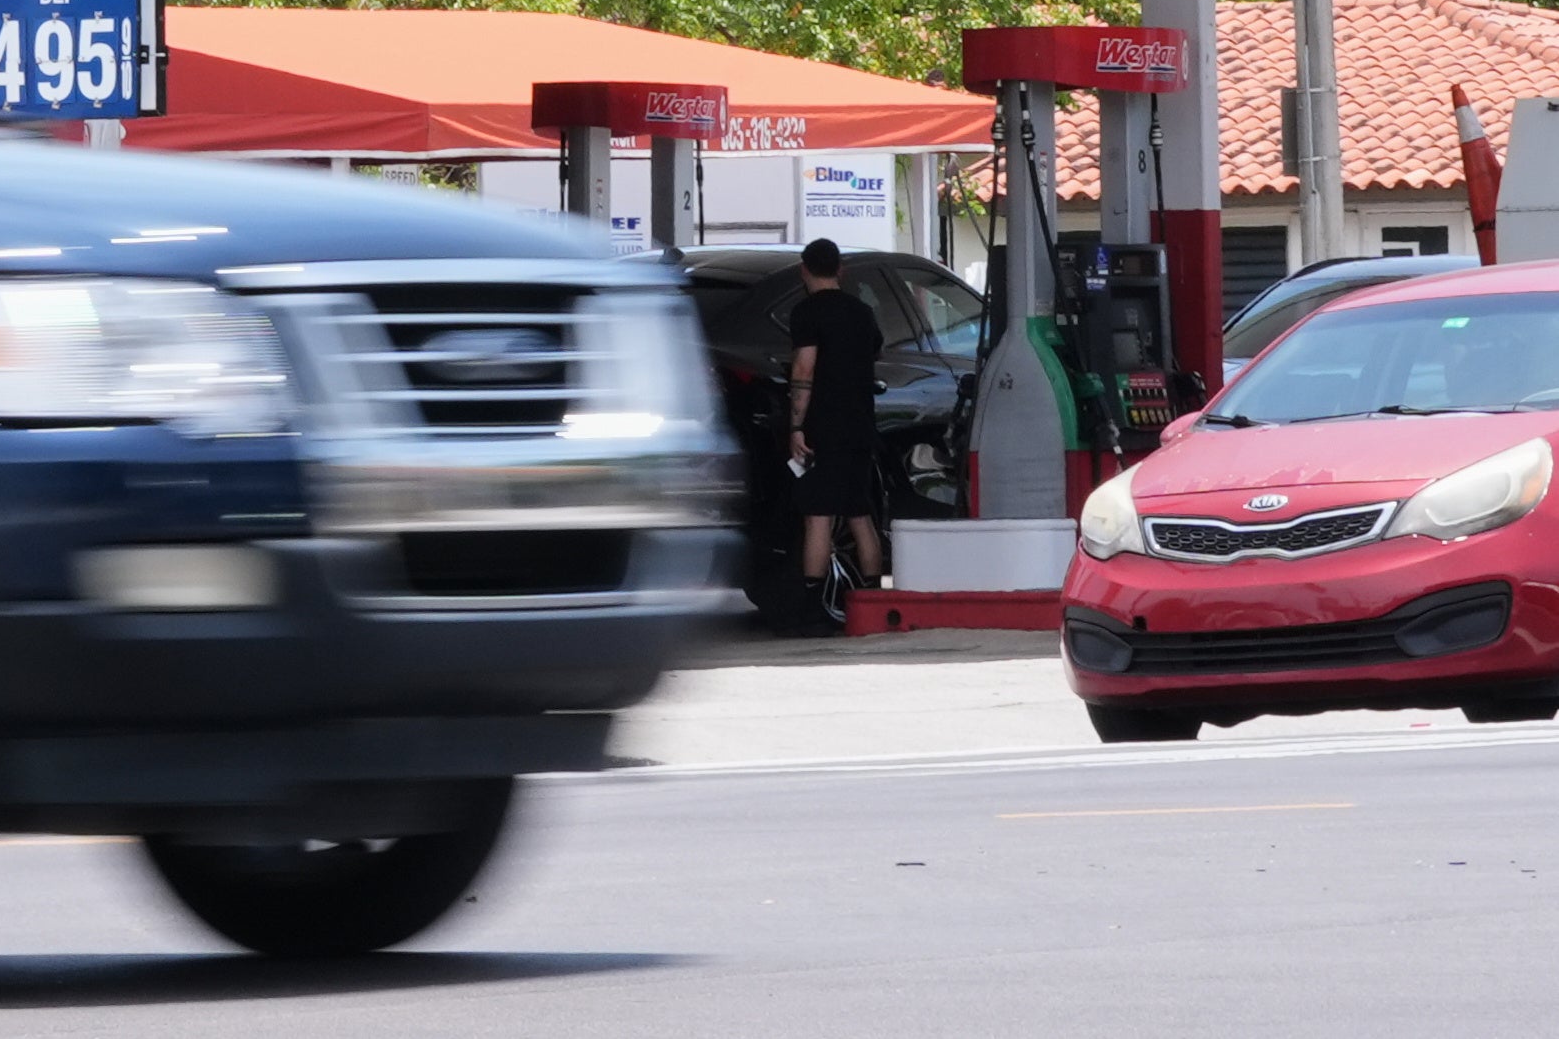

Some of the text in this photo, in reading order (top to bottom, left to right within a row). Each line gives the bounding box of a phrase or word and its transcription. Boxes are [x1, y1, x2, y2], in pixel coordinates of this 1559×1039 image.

[1097, 38, 1176, 72] Westar
[645, 92, 716, 122] Westar
[1139, 149, 1146, 174] 8
[683, 190, 691, 211] 2
[806, 204, 886, 217] DIESEL EXHAUST FLUID
[1249, 495, 1284, 509] KIA
